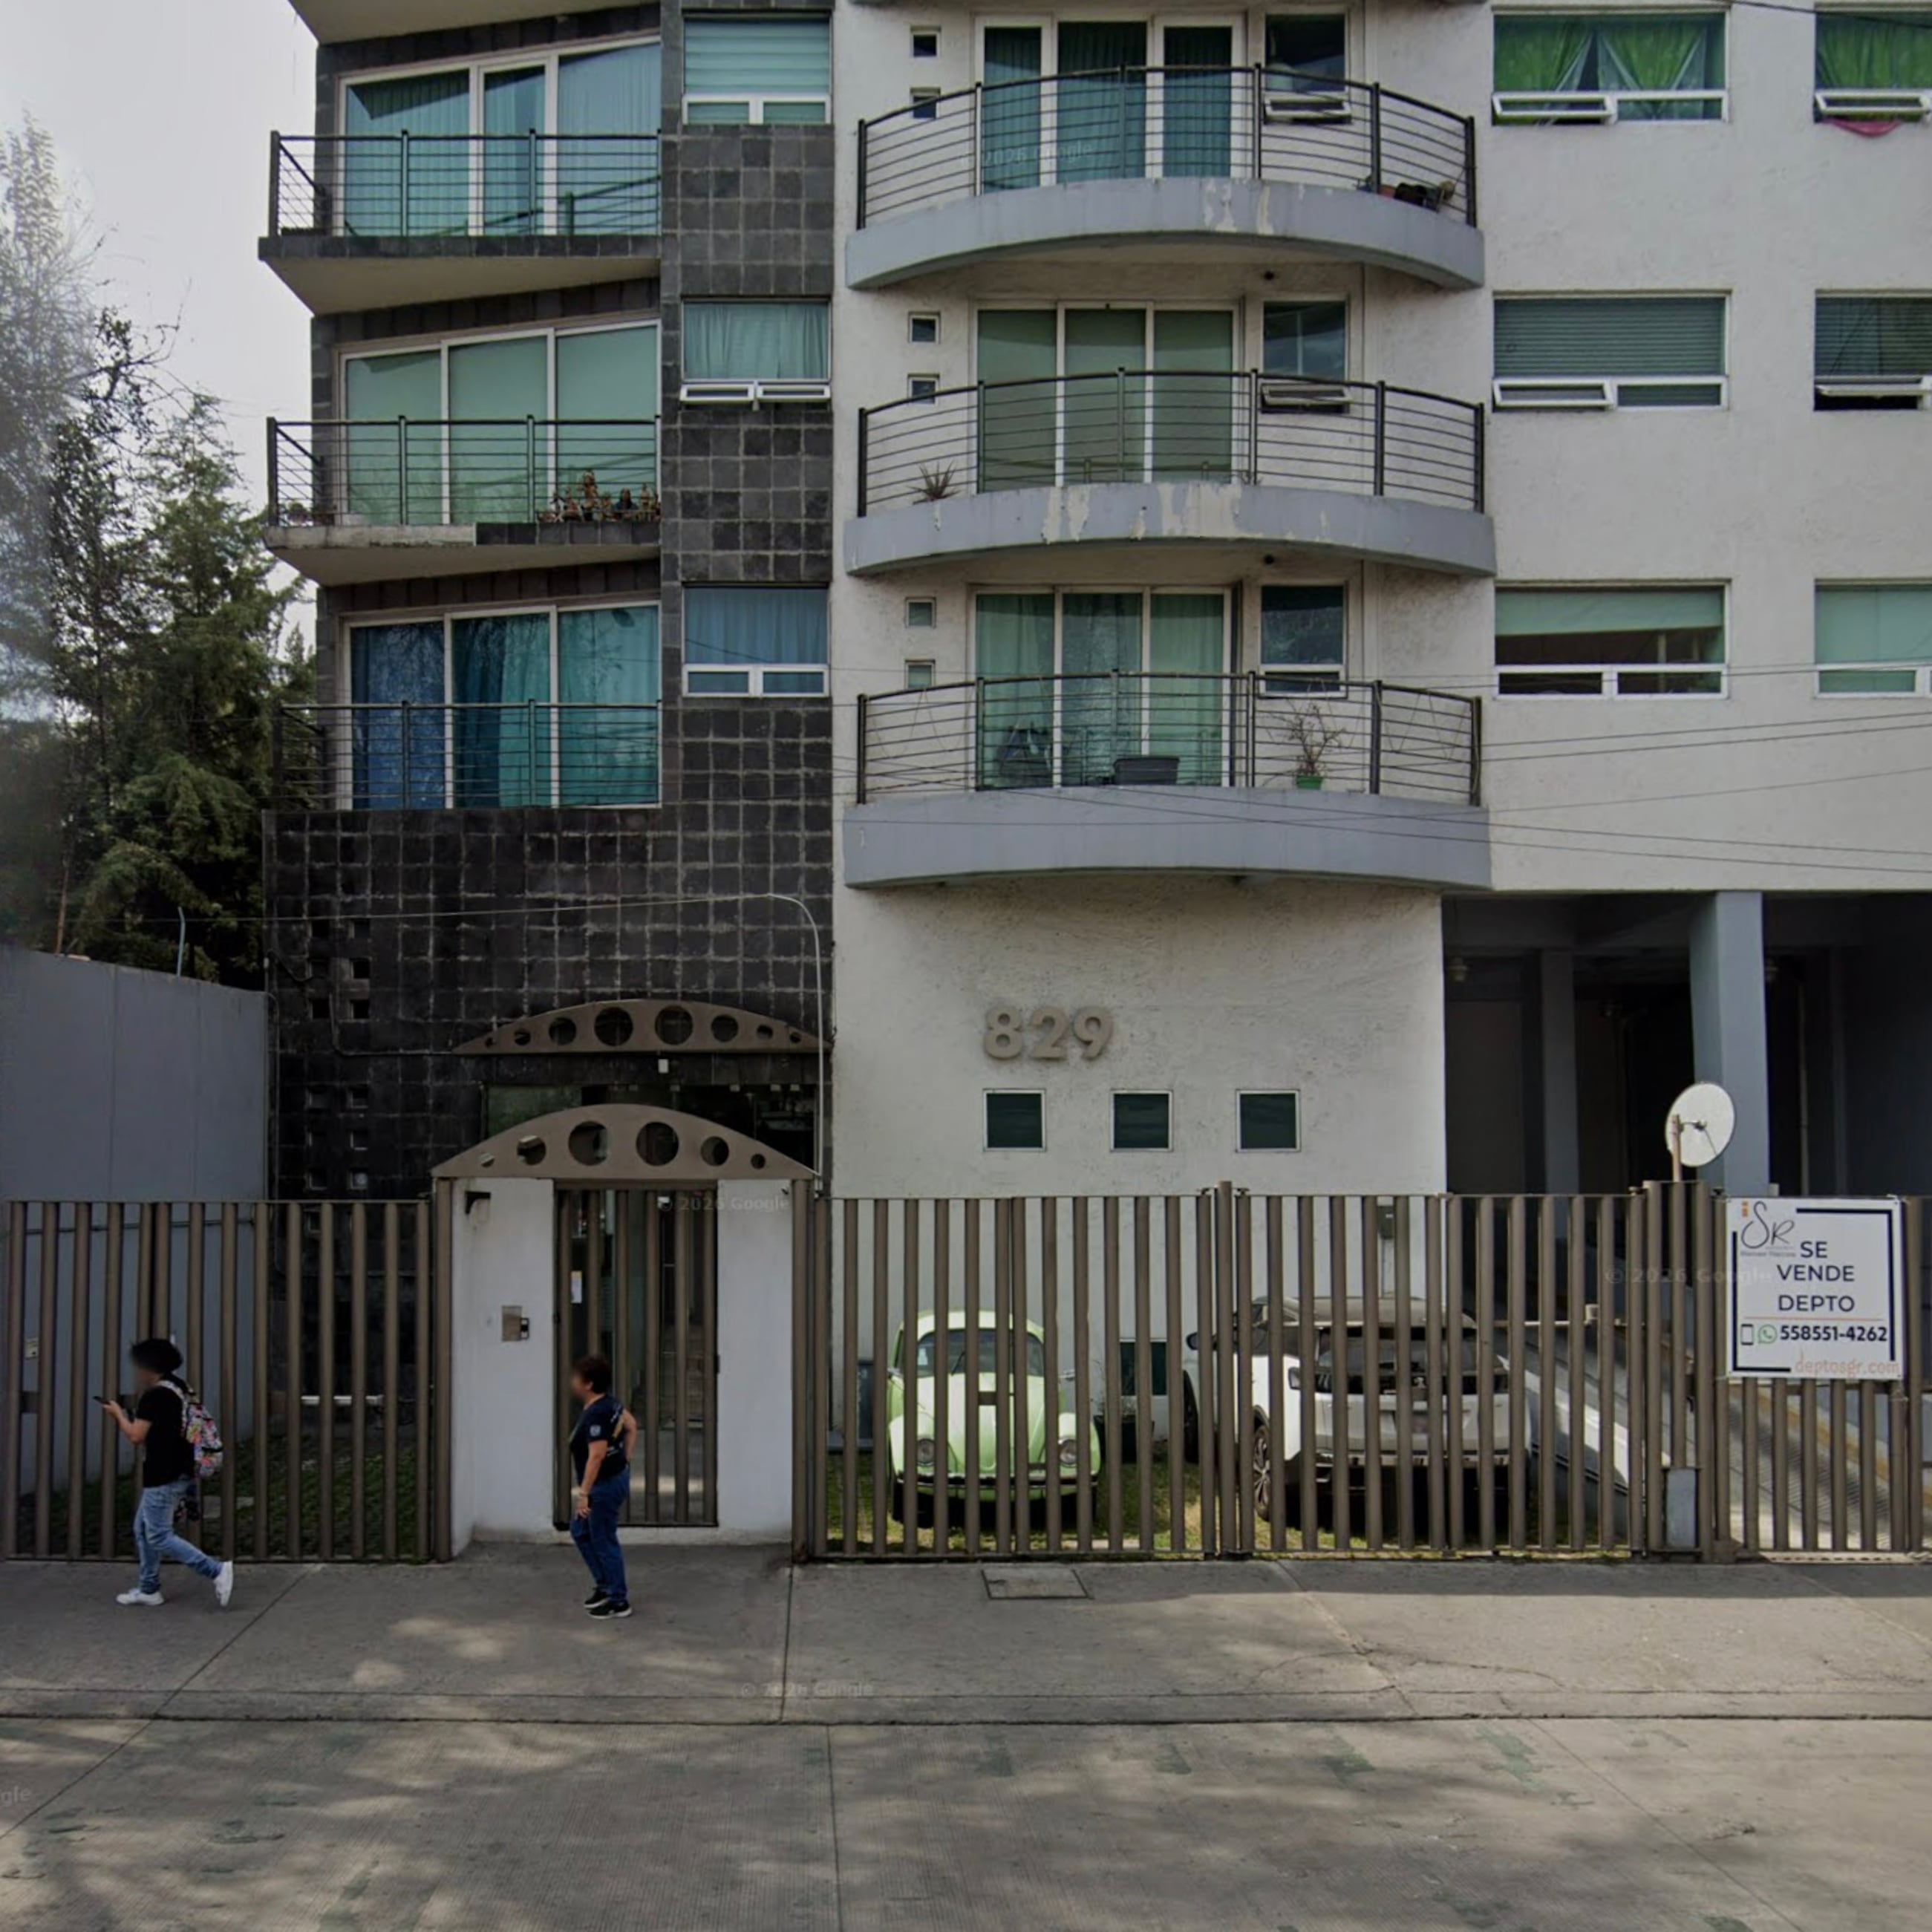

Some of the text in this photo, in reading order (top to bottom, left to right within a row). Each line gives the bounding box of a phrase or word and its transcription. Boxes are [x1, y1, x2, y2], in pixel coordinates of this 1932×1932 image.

[984, 1005, 1114, 1061] 829
[1800, 1241, 1828, 1259] SE
[1776, 1264, 1855, 1282] VENDE
[1778, 1294, 1855, 1312] DEPTO
[1780, 1325, 1887, 1342] 558551-4262
